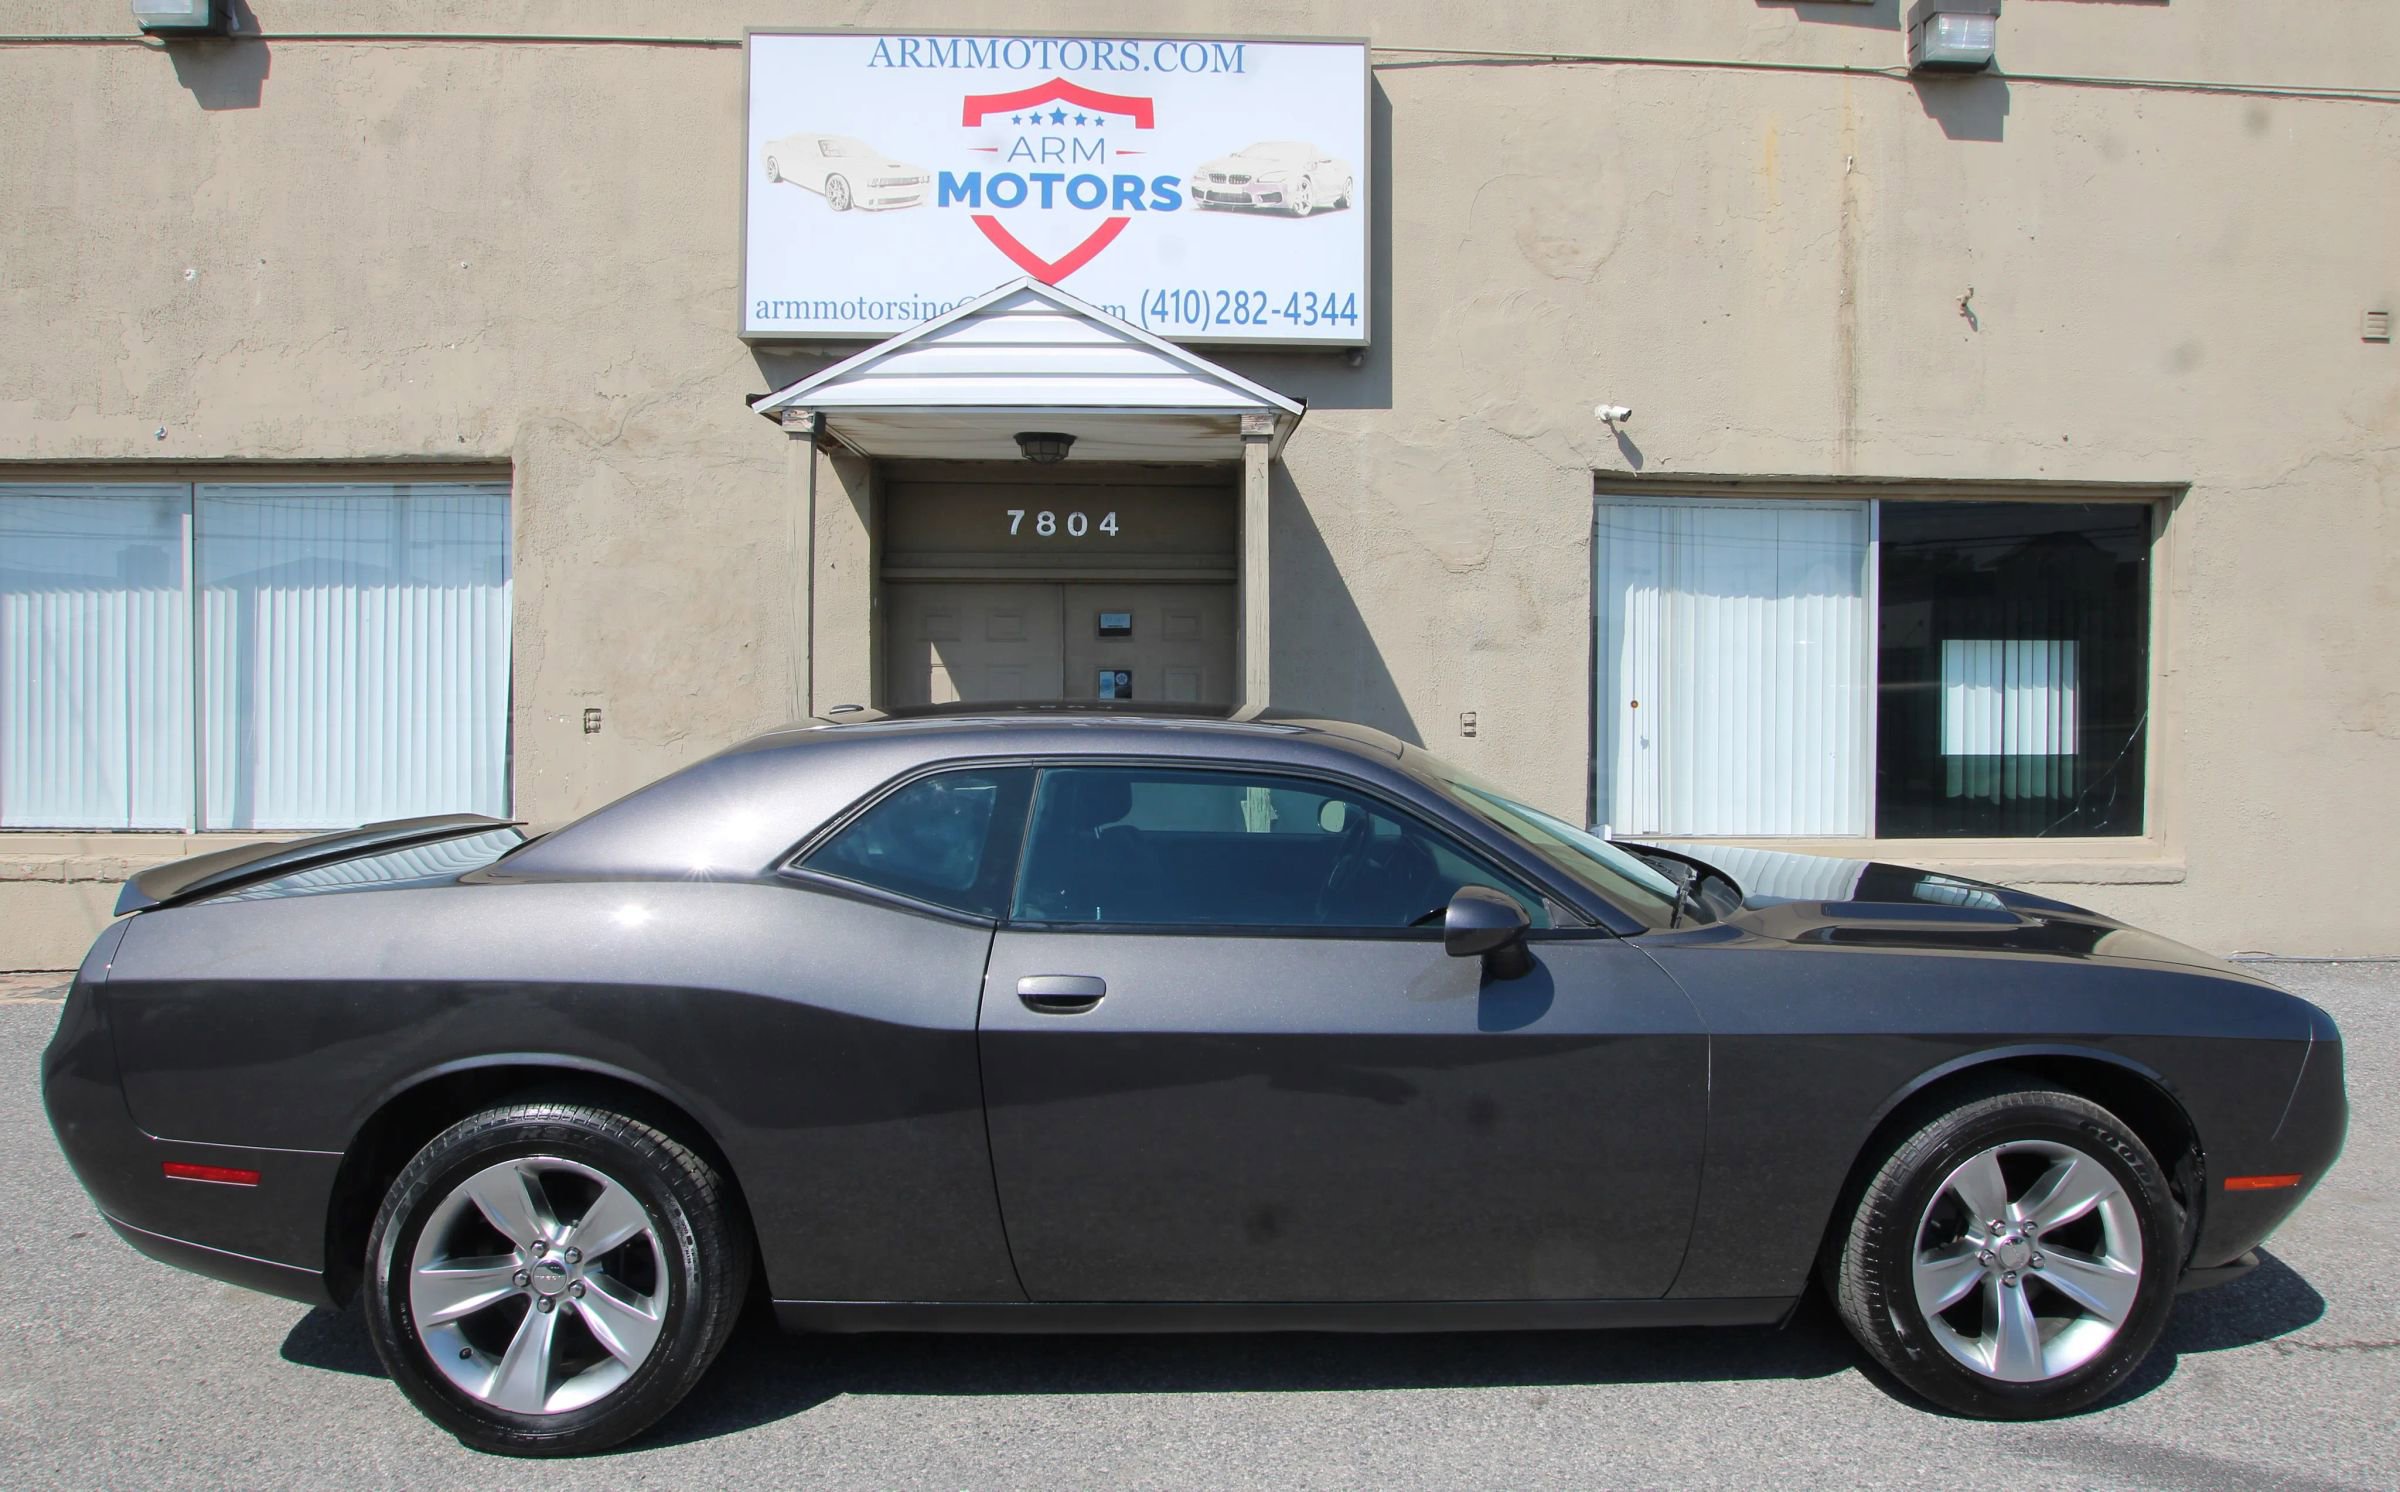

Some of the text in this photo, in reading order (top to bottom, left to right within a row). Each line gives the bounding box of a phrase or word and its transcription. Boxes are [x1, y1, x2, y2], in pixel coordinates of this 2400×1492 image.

[867, 37, 1246, 74] ARMMOTORS.COM
[1007, 136, 1106, 165] ARM
[937, 170, 1184, 213] MOTORS
[1141, 288, 1359, 331] (410)282-4344
[1007, 510, 1119, 537] 7804
